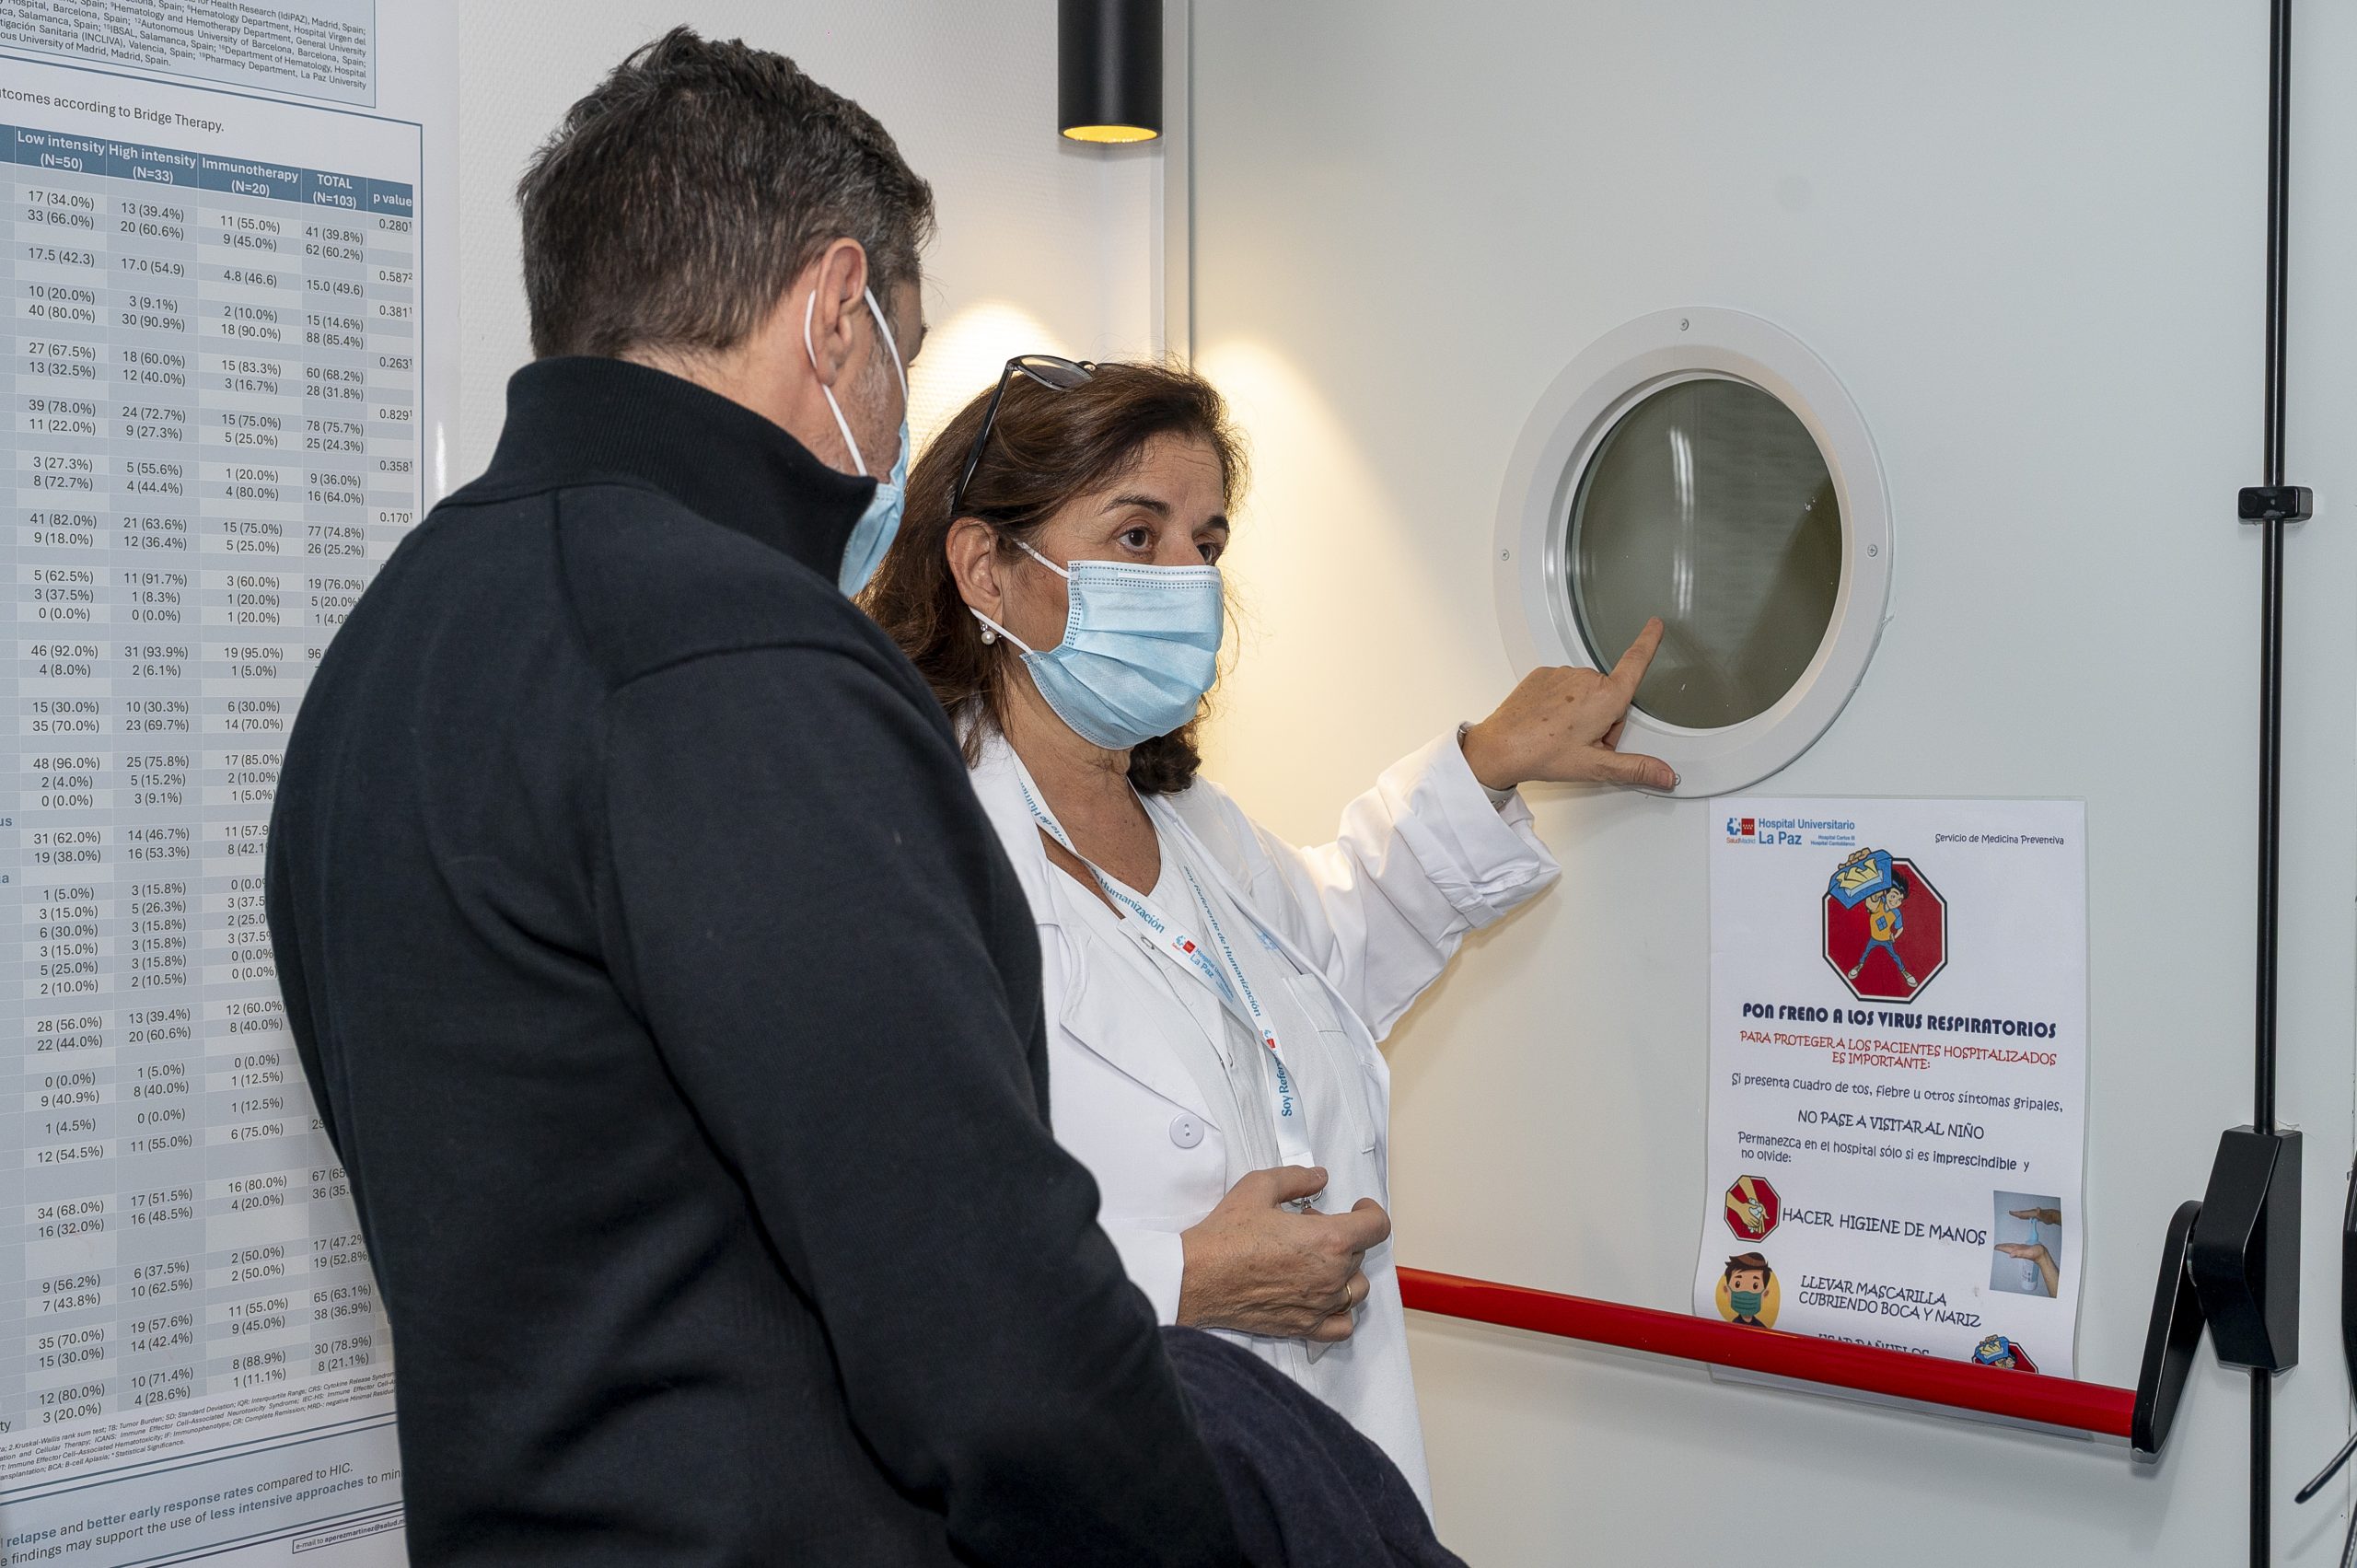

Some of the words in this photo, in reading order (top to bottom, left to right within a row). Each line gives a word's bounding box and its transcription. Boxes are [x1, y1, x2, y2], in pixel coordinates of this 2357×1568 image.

[19, 33, 63, 50] University
[76, 43, 109, 56] Madrid,
[110, 48, 143, 63] Madrid,
[145, 54, 171, 66] Spain.
[249, 61, 298, 77] Department,
[300, 70, 310, 79] La
[313, 72, 327, 82] Paz
[329, 75, 366, 90] University
[53, 97, 116, 118] according
[119, 105, 131, 117] to
[134, 108, 172, 124] Bridge
[175, 114, 225, 134] Therapy.
[17, 130, 45, 145] Low
[48, 134, 105, 156] intensity
[41, 153, 83, 172] (N=50)
[109, 144, 138, 160] High
[141, 148, 196, 169] intensity
[133, 166, 173, 183] (N=33)
[203, 157, 298, 183] Immunotherapy
[231, 180, 270, 198] (N=20)
[317, 174, 353, 189] TOTAL
[29, 191, 43, 202] 17
[47, 192, 94, 211] (34.0%)
[313, 191, 356, 210] (N=103)
[373, 194, 380, 204] p
[382, 194, 412, 207] value
[122, 203, 135, 214] 13
[139, 204, 183, 223] (39.4%)
[221, 215, 232, 226] 11
[238, 217, 280, 235] (55.0%)
[306, 226, 318, 238] 41
[323, 228, 363, 245] (39.8%)
[31, 645, 46, 656] 46
[51, 645, 98, 659] (92.0%)
[125, 646, 137, 656] 31
[144, 646, 188, 659] (93.9%)
[1759, 819, 1794, 830] Hospital
[1798, 819, 1854, 830] Universitario
[1759, 831, 1773, 844] La
[1779, 831, 1802, 844] Paz
[1935, 834, 1967, 843] Servicio
[1968, 834, 1979, 842] de
[1981, 834, 2018, 843] Medicina
[2021, 835, 2063, 844] Preventiva
[1099, 877, 1165, 934] Humanización
[1194, 884, 1220, 933] Referente
[1217, 932, 1225, 945] de
[1224, 945, 1261, 1017] Humanización
[1190, 954, 1200, 965] La
[1201, 963, 1214, 979] Paz
[38, 1021, 52, 1032] 28
[56, 1016, 101, 1033] (56.0%)
[129, 1013, 143, 1024] 13
[146, 1008, 190, 1025] (39.4%)
[1743, 1003, 1773, 1018] PON
[1779, 1005, 1829, 1022] FRENO
[1833, 1009, 1842, 1023] A
[1848, 1010, 1874, 1026] LOS
[1878, 1012, 1922, 1028] VIRUS
[1928, 1016, 2056, 1039] RESPIRATORIOS
[1740, 1030, 1771, 1043] PARA
[1774, 1033, 1835, 1049] PROTEGER
[1836, 1038, 1845, 1049] A
[1848, 1039, 1871, 1052] LOS
[1874, 1040, 1941, 1057] PACIENTES
[1945, 1046, 2057, 1066] HOSPITALIZADOS
[1832, 1051, 1846, 1064] ES
[1849, 1053, 1930, 1069] IMPORTANTE:
[1732, 1073, 1741, 1086] Si
[1745, 1076, 1789, 1088] presenta
[1794, 1079, 1831, 1091] cuadro
[1835, 1082, 1849, 1093] de
[1852, 1085, 1872, 1096] tos,
[1876, 1085, 1910, 1098] fiebre
[1914, 1090, 1921, 1099] u
[1924, 1091, 1955, 1102] otros
[1958, 1091, 2010, 1107] síntomas
[2014, 1098, 2062, 1112] gripales,
[1282, 1096, 1293, 1117] Soy
[1798, 1109, 1817, 1123] NO
[1820, 1111, 1853, 1127] PASE
[1856, 1115, 1866, 1128] A
[1870, 1117, 1923, 1133] VISITAR
[1924, 1121, 1945, 1135] AL
[1948, 1122, 1984, 1139] NIÑO
[1738, 1132, 1801, 1149] Permanezca
[1805, 1140, 1817, 1149] en
[1821, 1142, 1829, 1152] el
[1834, 1142, 1875, 1156] hospital
[1880, 1145, 1902, 1158] sólo
[1906, 1149, 1913, 1159] si
[1918, 1152, 1929, 1161] es
[1933, 1151, 2016, 1170] imprescindible
[2023, 1159, 2030, 1172] y
[1742, 1149, 1754, 1158] no
[1757, 1150, 1791, 1162] olvide:
[1782, 1208, 1834, 1226] HACER
[1840, 1214, 1900, 1234] HIGIENE
[1905, 1222, 1924, 1237] DE
[1929, 1225, 1987, 1246] MANOS
[314, 1291, 327, 1303] 65
[331, 1283, 371, 1302] (63.1%)
[1801, 1275, 1853, 1295] LLEVAR
[1856, 1283, 1946, 1307] MASCARILLA
[229, 1306, 240, 1317] 11
[246, 1297, 288, 1317] (55.0%)
[1799, 1289, 1877, 1313] CUBRIENDO
[1881, 1302, 1920, 1319] BOCA
[1924, 1307, 1933, 1321] Y
[1935, 1309, 1981, 1327] NARIZ
[132, 1322, 145, 1333] 19
[148, 1314, 192, 1333] (57.6%)
[39, 1337, 53, 1349] 35
[58, 1329, 104, 1349] (70.0%)
[6, 1528, 57, 1548] relapse
[60, 1521, 84, 1536] and
[87, 1514, 126, 1530] better
[129, 1505, 161, 1521] early
[164, 1493, 220, 1514] response
[223, 1485, 254, 1500] rates
[256, 1470, 313, 1492] compared
[316, 1469, 327, 1480] to
[330, 1462, 354, 1476] HIC.
[12, 1545, 62, 1564] findings
[65, 1539, 92, 1552] may
[96, 1526, 144, 1546] support
[146, 1522, 167, 1534] the
[170, 1516, 192, 1529] use
[194, 1511, 207, 1524] of
[210, 1505, 236, 1520] less
[238, 1493, 292, 1514] intensive
[296, 1478, 364, 1502] approaches
[366, 1475, 377, 1485] to
